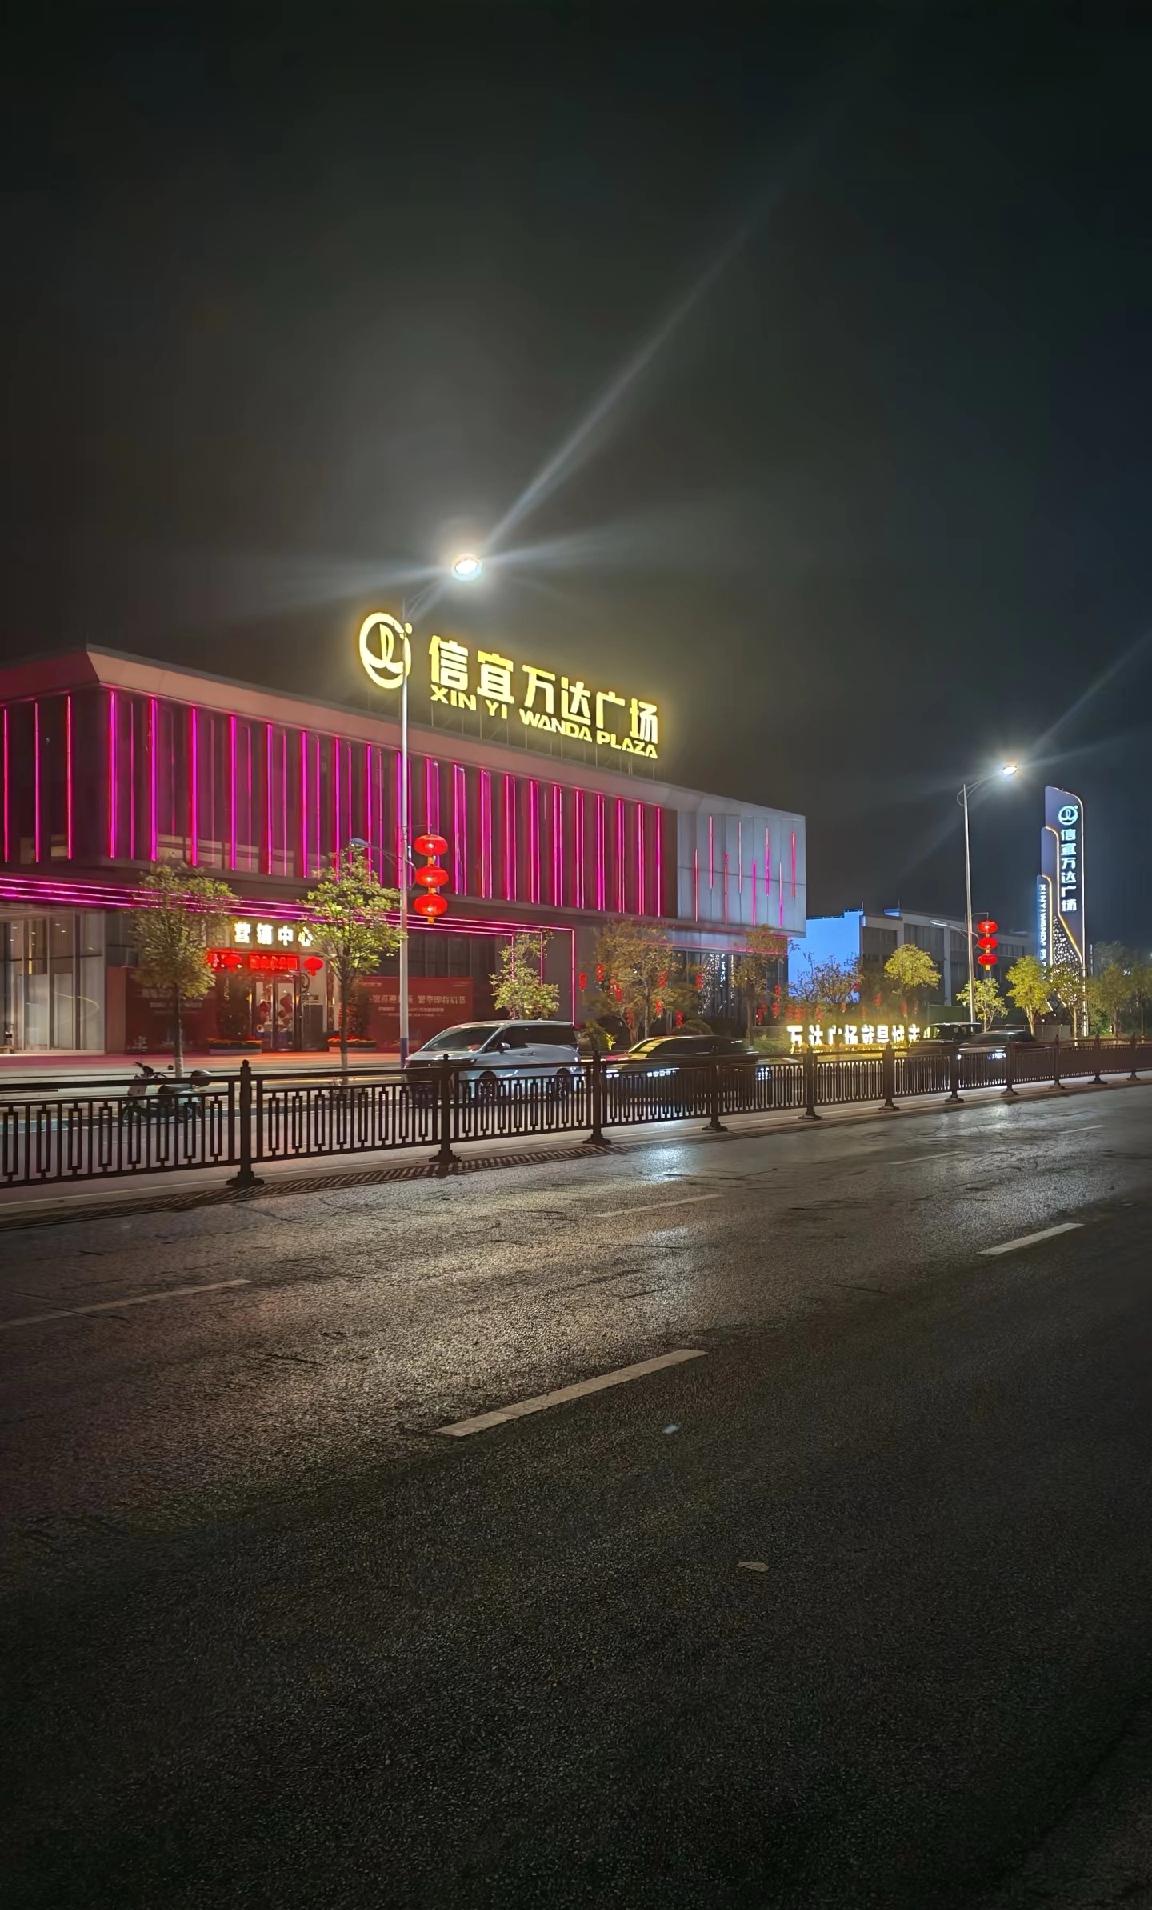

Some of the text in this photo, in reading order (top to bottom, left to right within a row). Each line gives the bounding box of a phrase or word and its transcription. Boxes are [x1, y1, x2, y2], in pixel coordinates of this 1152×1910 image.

[429, 634, 659, 744] 信宜万达广场
[430, 684, 659, 759] XIN YI WANDA PLAZA
[1061, 828, 1077, 911] 信宜万达广场
[234, 921, 314, 947] 营销中心
